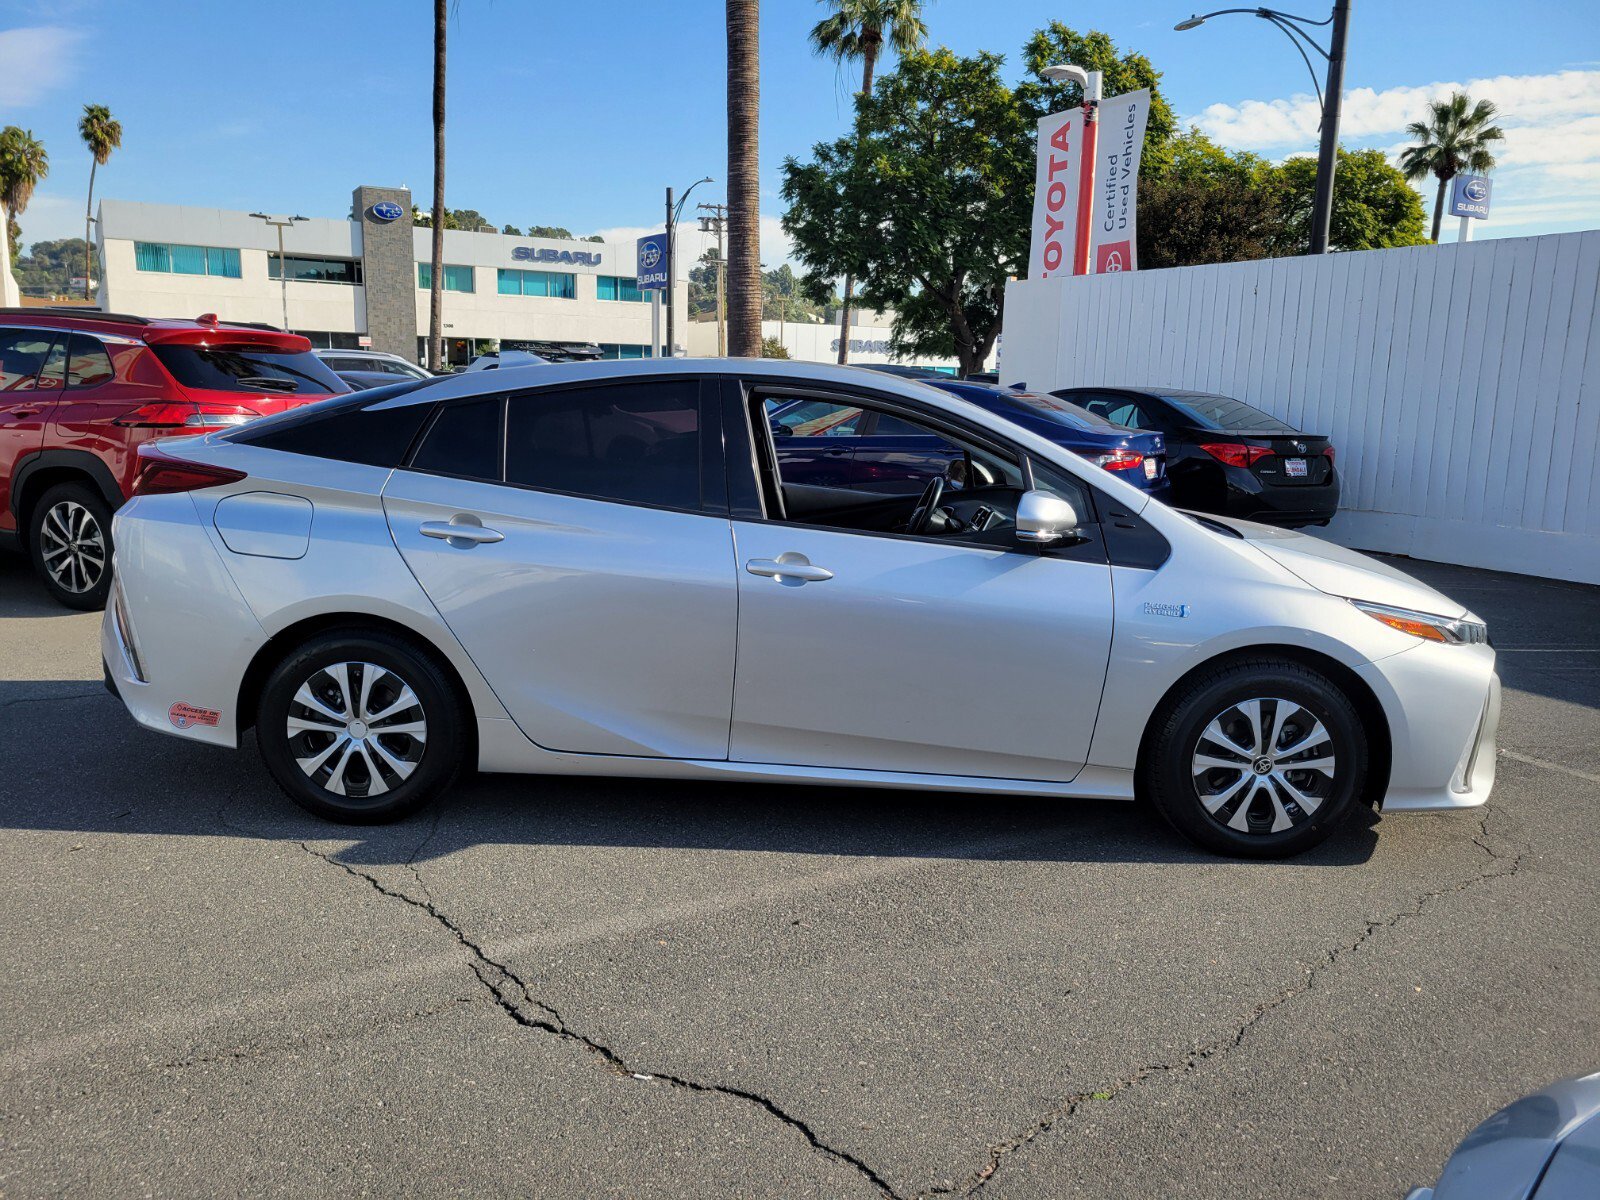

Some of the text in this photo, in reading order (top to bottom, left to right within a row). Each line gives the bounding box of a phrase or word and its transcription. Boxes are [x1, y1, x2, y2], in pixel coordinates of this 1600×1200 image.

[1118, 103, 1137, 230] Used Vehicles
[1042, 120, 1072, 279] OYOTA
[1104, 154, 1118, 232] Certified
[1457, 202, 1489, 215] SUBARU
[511, 246, 602, 267] SUBARU
[637, 272, 667, 285] SUBARU
[182, 706, 208, 714] ACCESS
